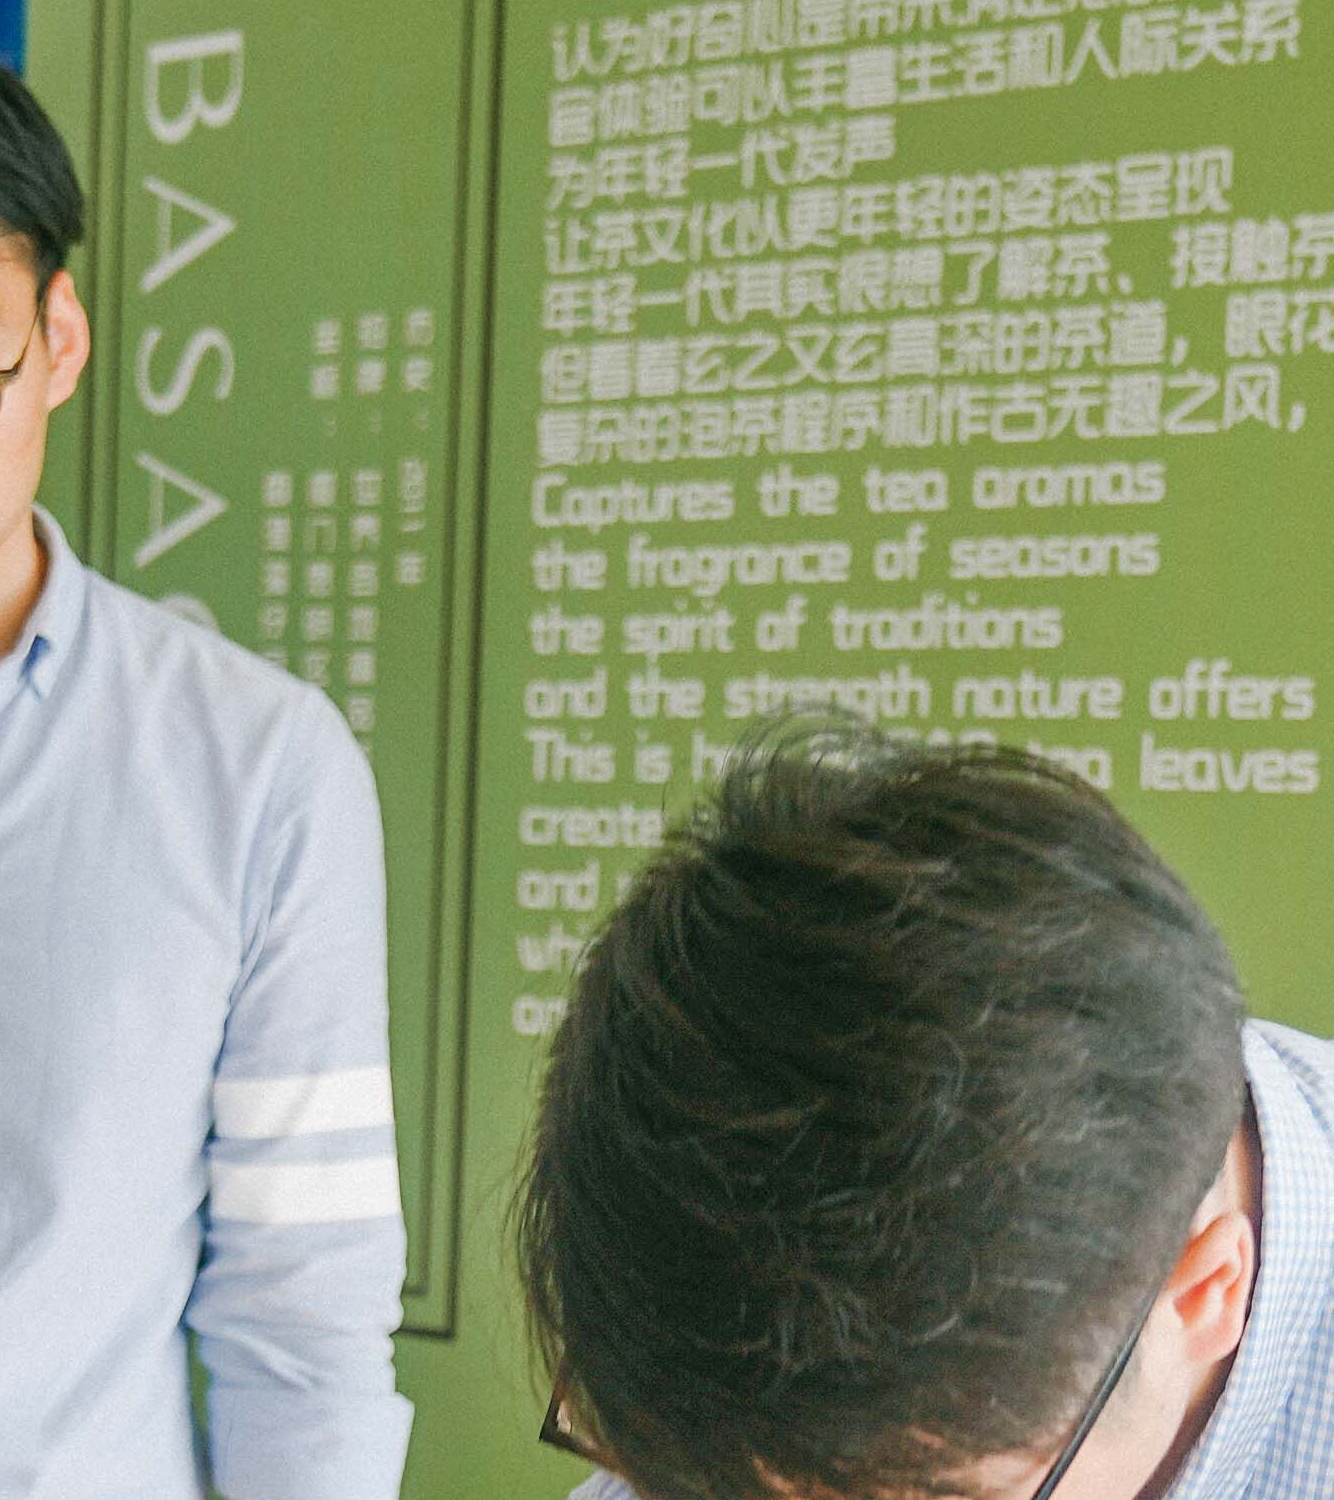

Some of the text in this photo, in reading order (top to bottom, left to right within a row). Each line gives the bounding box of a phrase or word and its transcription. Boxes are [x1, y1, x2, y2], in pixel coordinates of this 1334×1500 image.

[546, 114, 898, 212] 为年轻一代发声
[531, 453, 1165, 534] Captures the tea aromas
[533, 523, 1161, 597] the fragrance of seasons
[531, 592, 1063, 662] the spirit of traditions
[525, 666, 608, 720] and
[628, 662, 705, 719] the
[951, 668, 1124, 720] nature
[1149, 657, 1316, 721] offers
[526, 728, 615, 783] This
[635, 730, 672, 784] is
[1141, 730, 1320, 793] leaves
[518, 860, 599, 912] and
